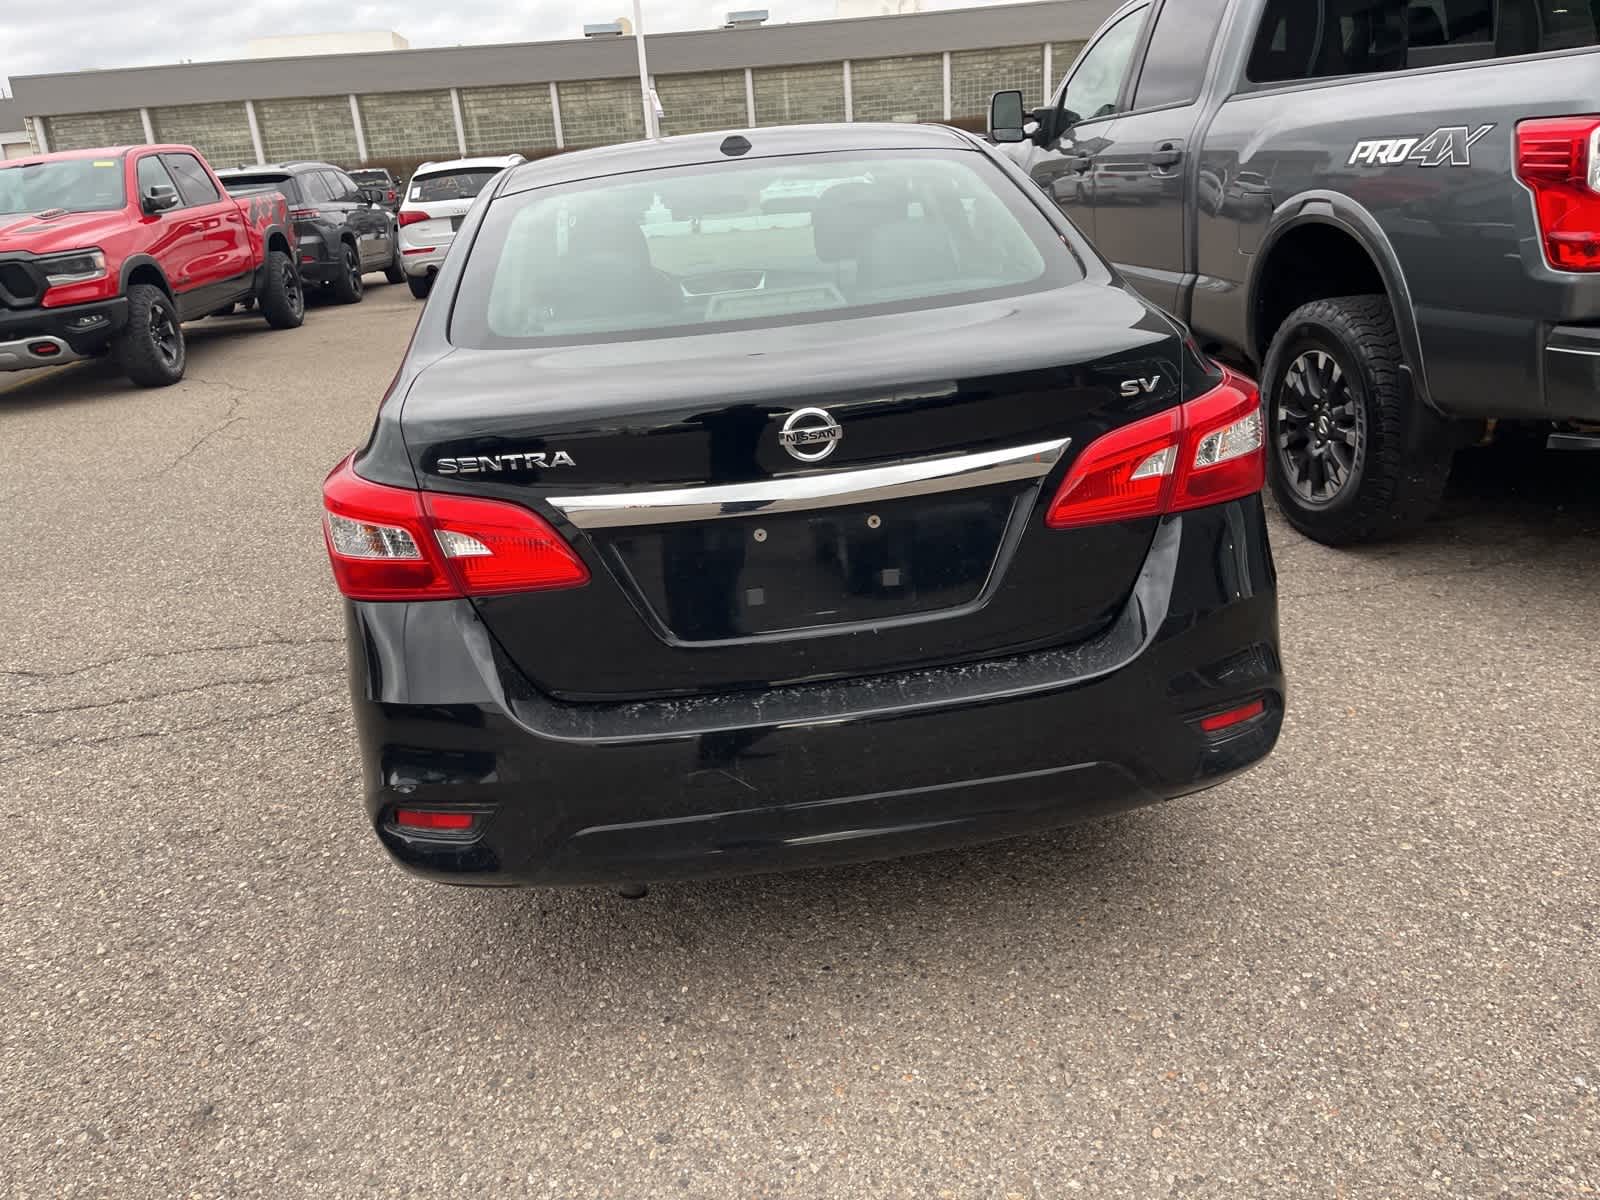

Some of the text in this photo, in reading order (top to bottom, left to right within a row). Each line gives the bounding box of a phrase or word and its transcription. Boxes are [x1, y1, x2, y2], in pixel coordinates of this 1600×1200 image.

[1120, 375, 1160, 397] SV
[785, 429, 837, 443] NISSAN
[437, 451, 577, 474] SENTRA
